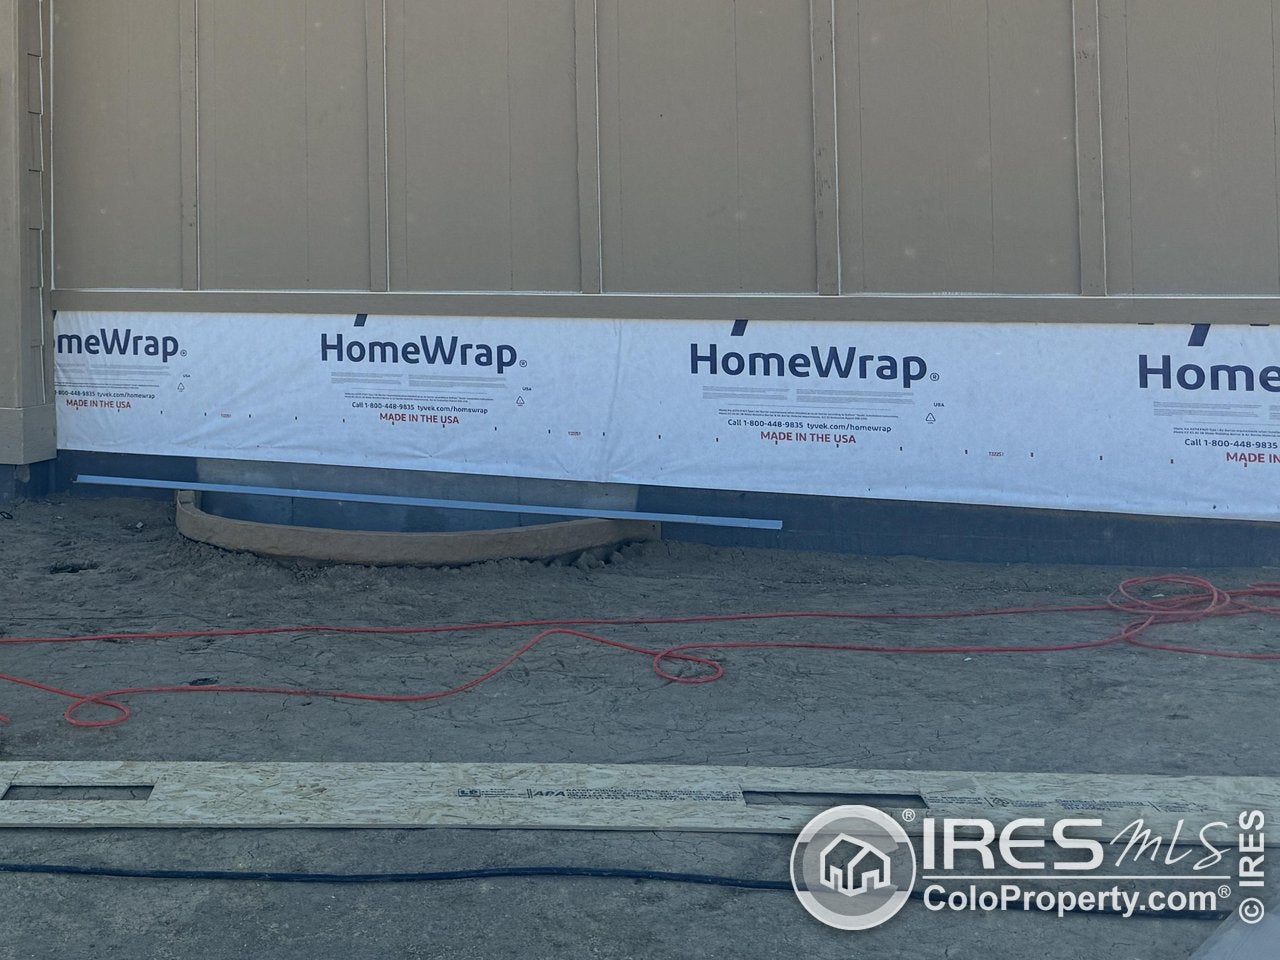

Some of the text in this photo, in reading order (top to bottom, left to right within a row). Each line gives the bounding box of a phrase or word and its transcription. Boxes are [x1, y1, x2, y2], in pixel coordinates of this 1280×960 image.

[321, 333, 517, 374] HomeWrap
[690, 343, 927, 388] HomeWrap
[1138, 354, 1280, 392] Home
[100, 400, 114, 408] THE
[380, 413, 459, 424] MADE IN THE USA
[761, 431, 856, 443] MADE IN THE USA
[1204, 439, 1278, 449] 1-800-448-9835
[1226, 452, 1280, 463] MADE IN
